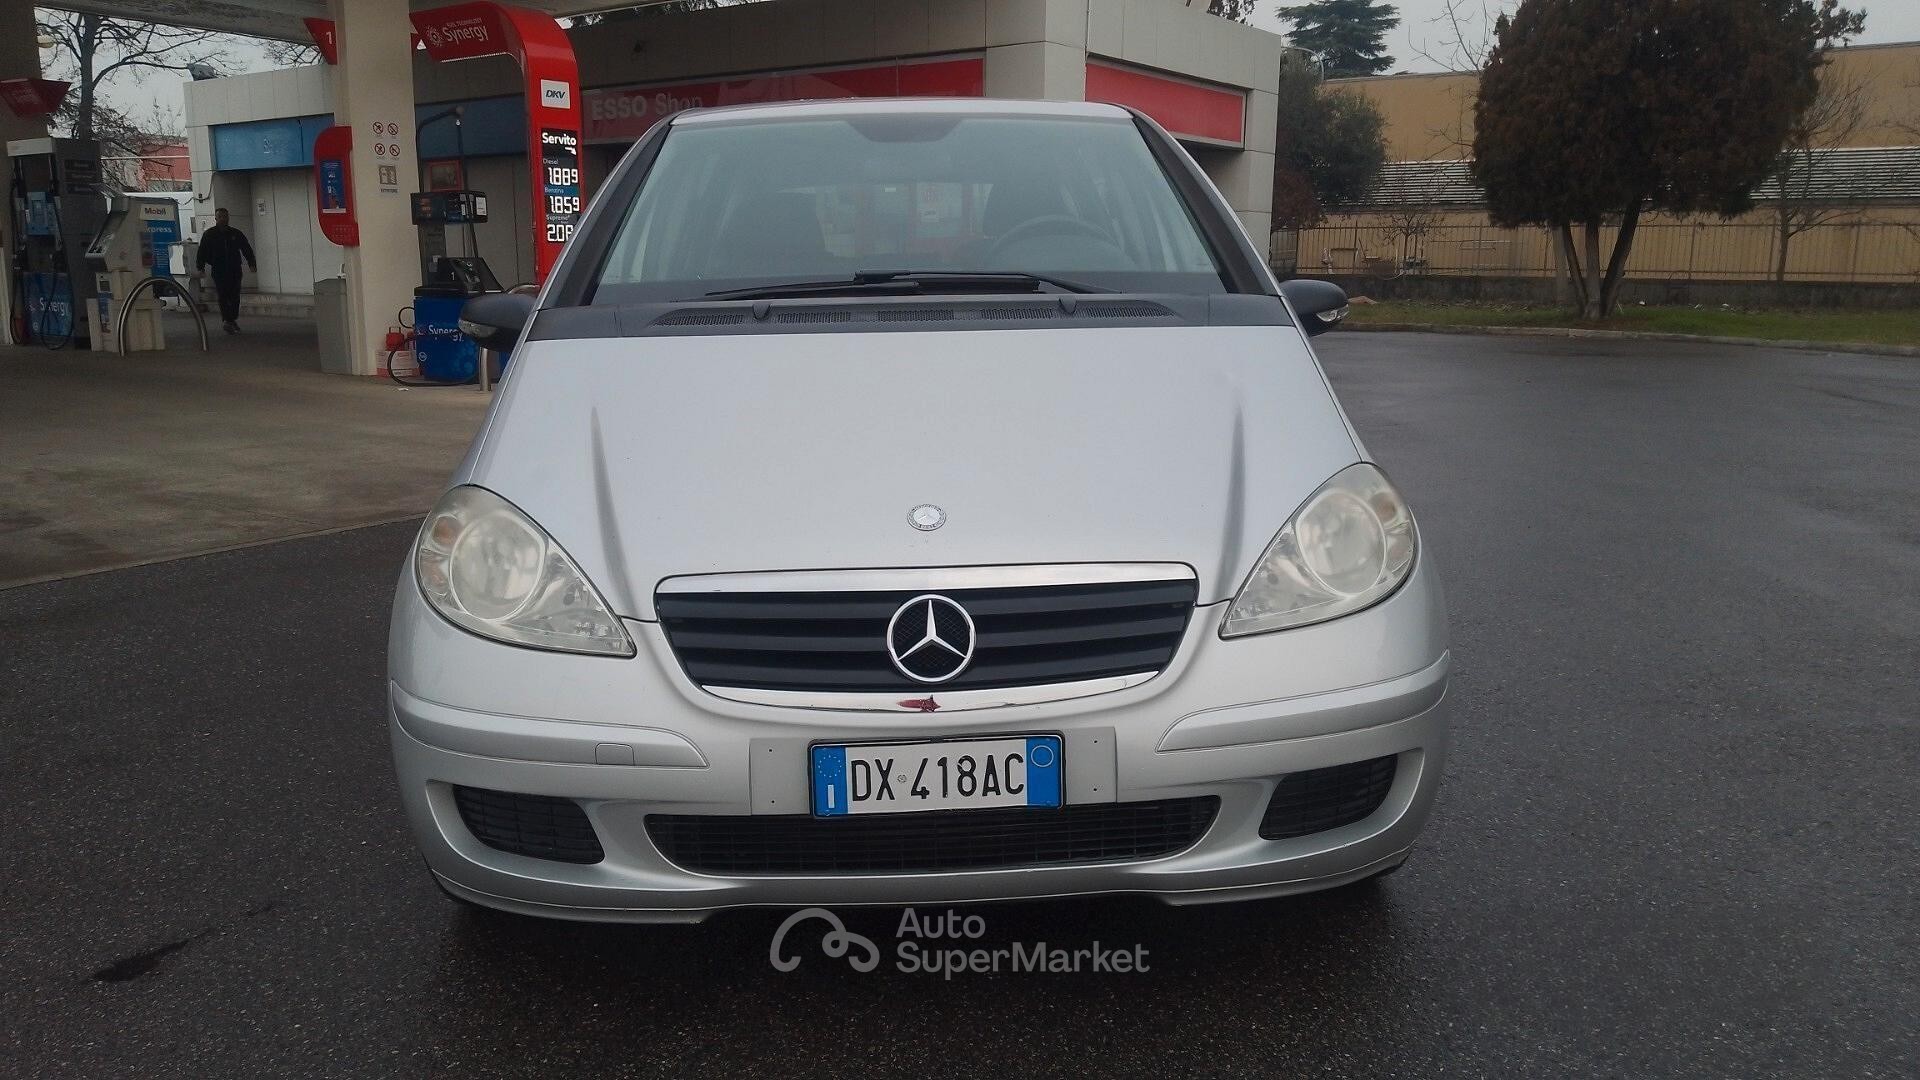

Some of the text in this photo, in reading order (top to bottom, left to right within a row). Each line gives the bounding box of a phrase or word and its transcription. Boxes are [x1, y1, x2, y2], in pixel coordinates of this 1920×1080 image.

[326, 31, 333, 45] 1
[442, 26, 489, 45] Synergy
[546, 89, 566, 100] DKV
[591, 95, 648, 121] ESSO
[541, 132, 577, 146] Servito
[144, 207, 167, 215] Mobil
[450, 271, 455, 281] 1
[851, 752, 1025, 802] DX 418AC
